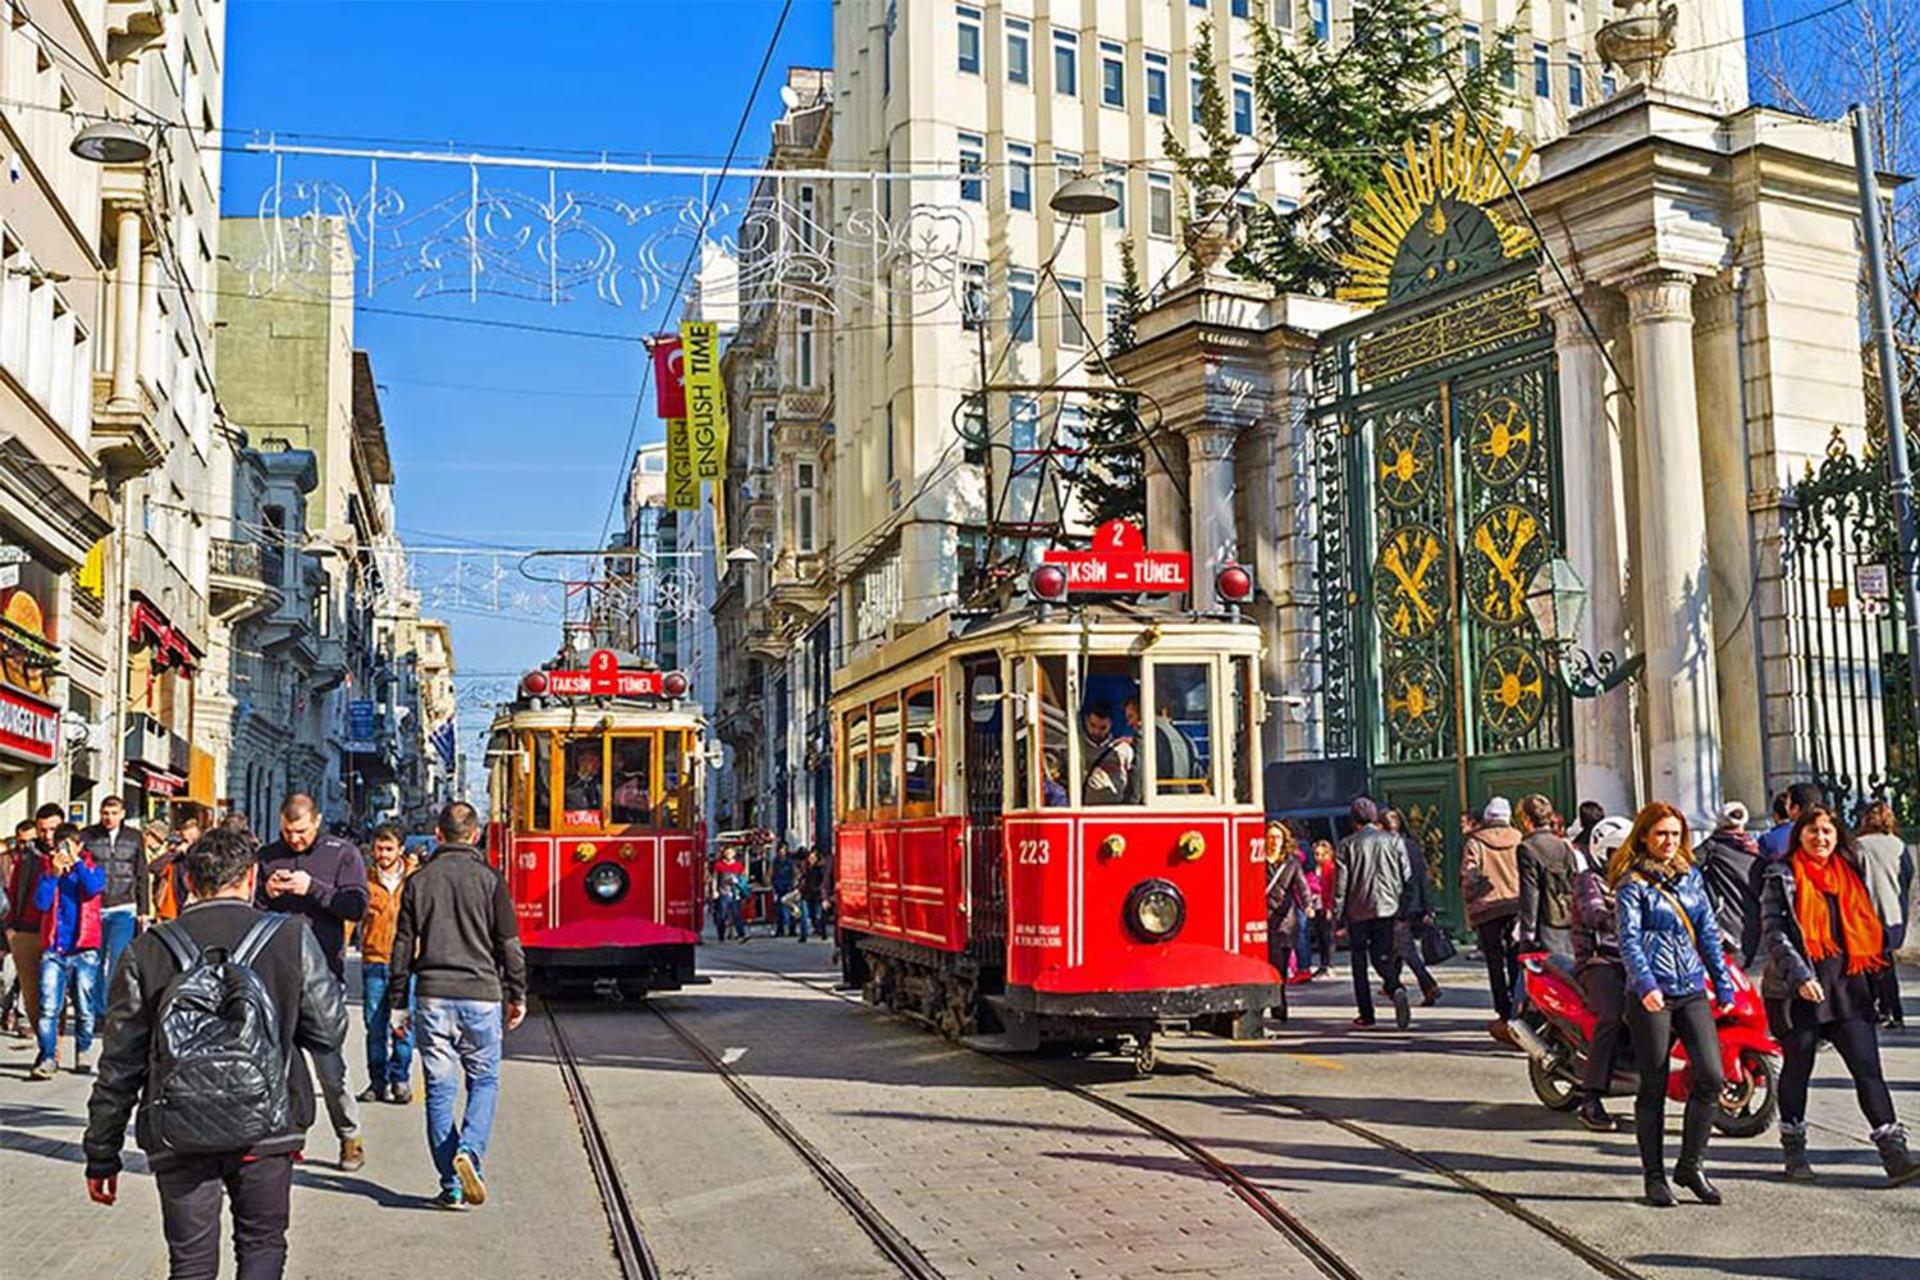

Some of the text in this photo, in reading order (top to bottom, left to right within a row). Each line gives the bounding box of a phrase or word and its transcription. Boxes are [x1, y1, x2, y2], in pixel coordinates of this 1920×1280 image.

[690, 326, 718, 477] ENGLISH TIME
[1112, 523, 1125, 547] 2
[1134, 558, 1185, 583] TÜNEL
[598, 653, 609, 671] 3
[1019, 840, 1050, 865] 223
